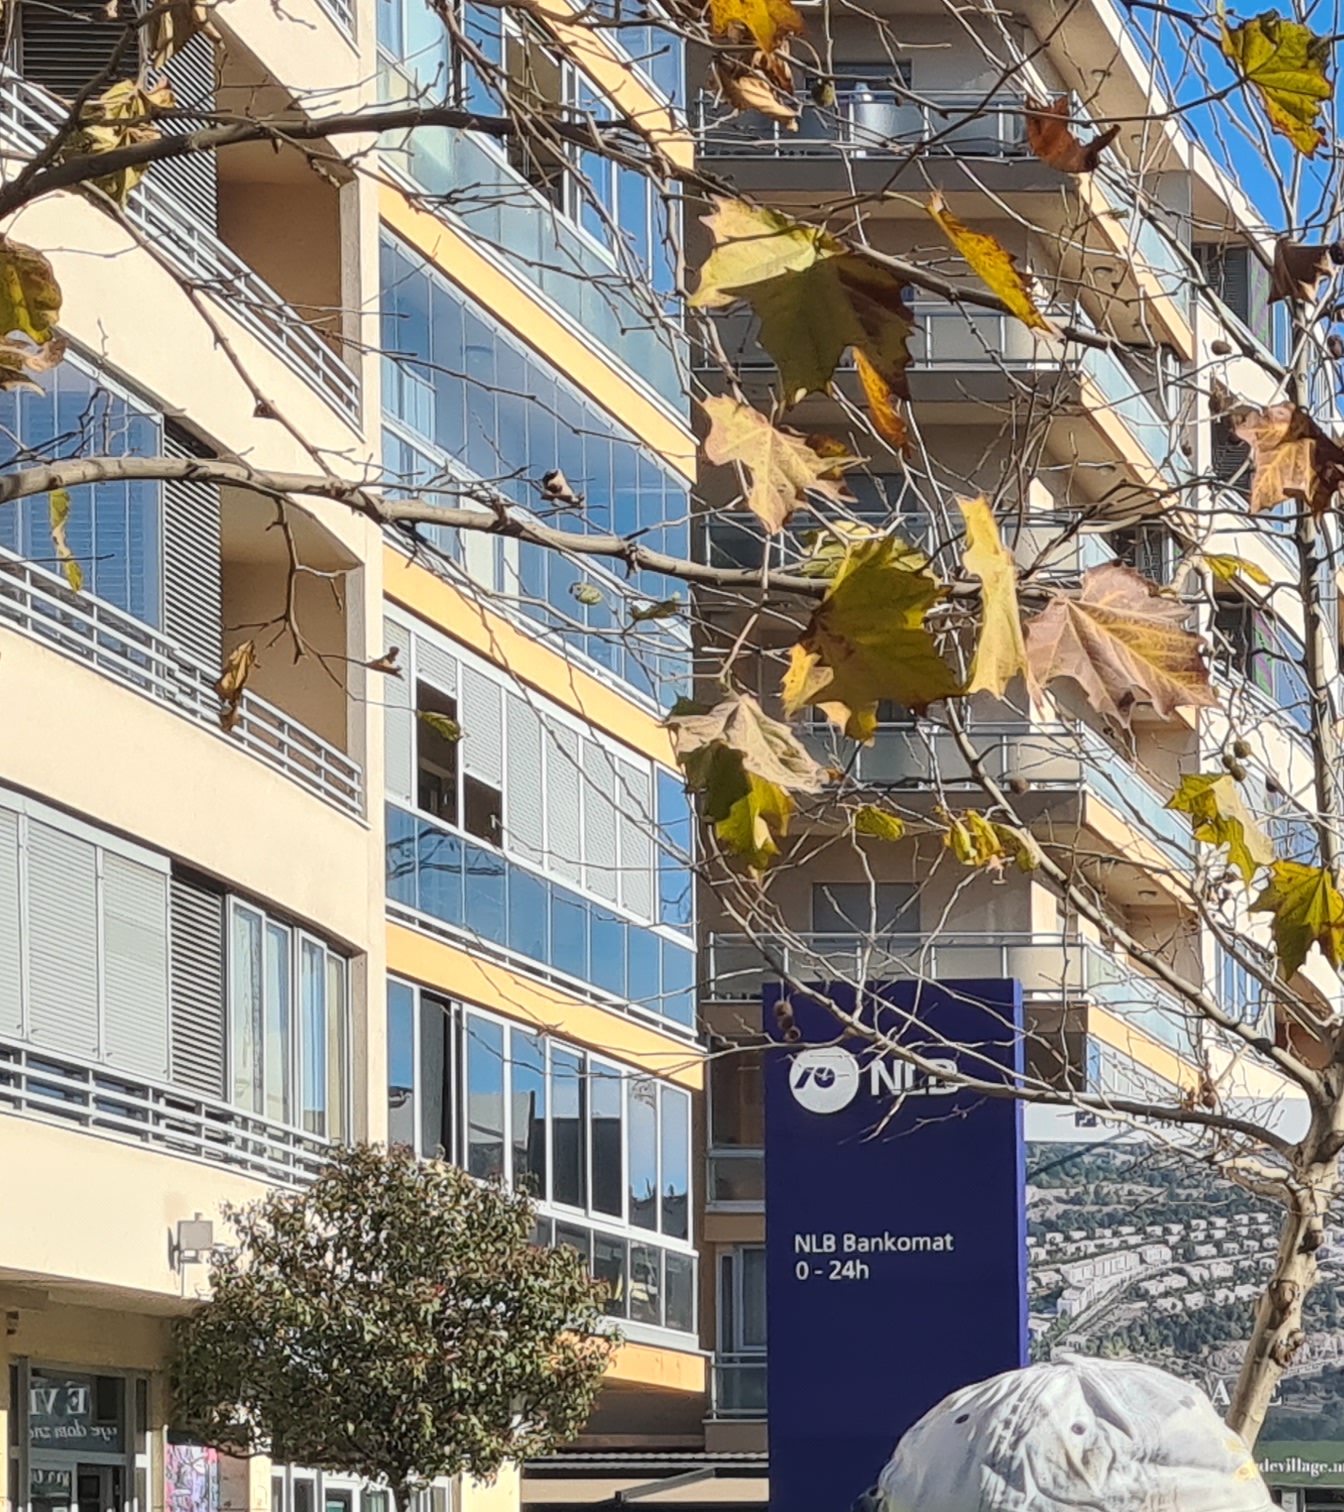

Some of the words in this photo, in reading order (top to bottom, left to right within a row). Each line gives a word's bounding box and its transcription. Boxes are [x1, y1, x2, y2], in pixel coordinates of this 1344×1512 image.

[794, 1233, 836, 1253] NLB
[843, 1231, 954, 1252] Bankomat
[795, 1260, 809, 1281] 0
[828, 1259, 870, 1281] 24h
